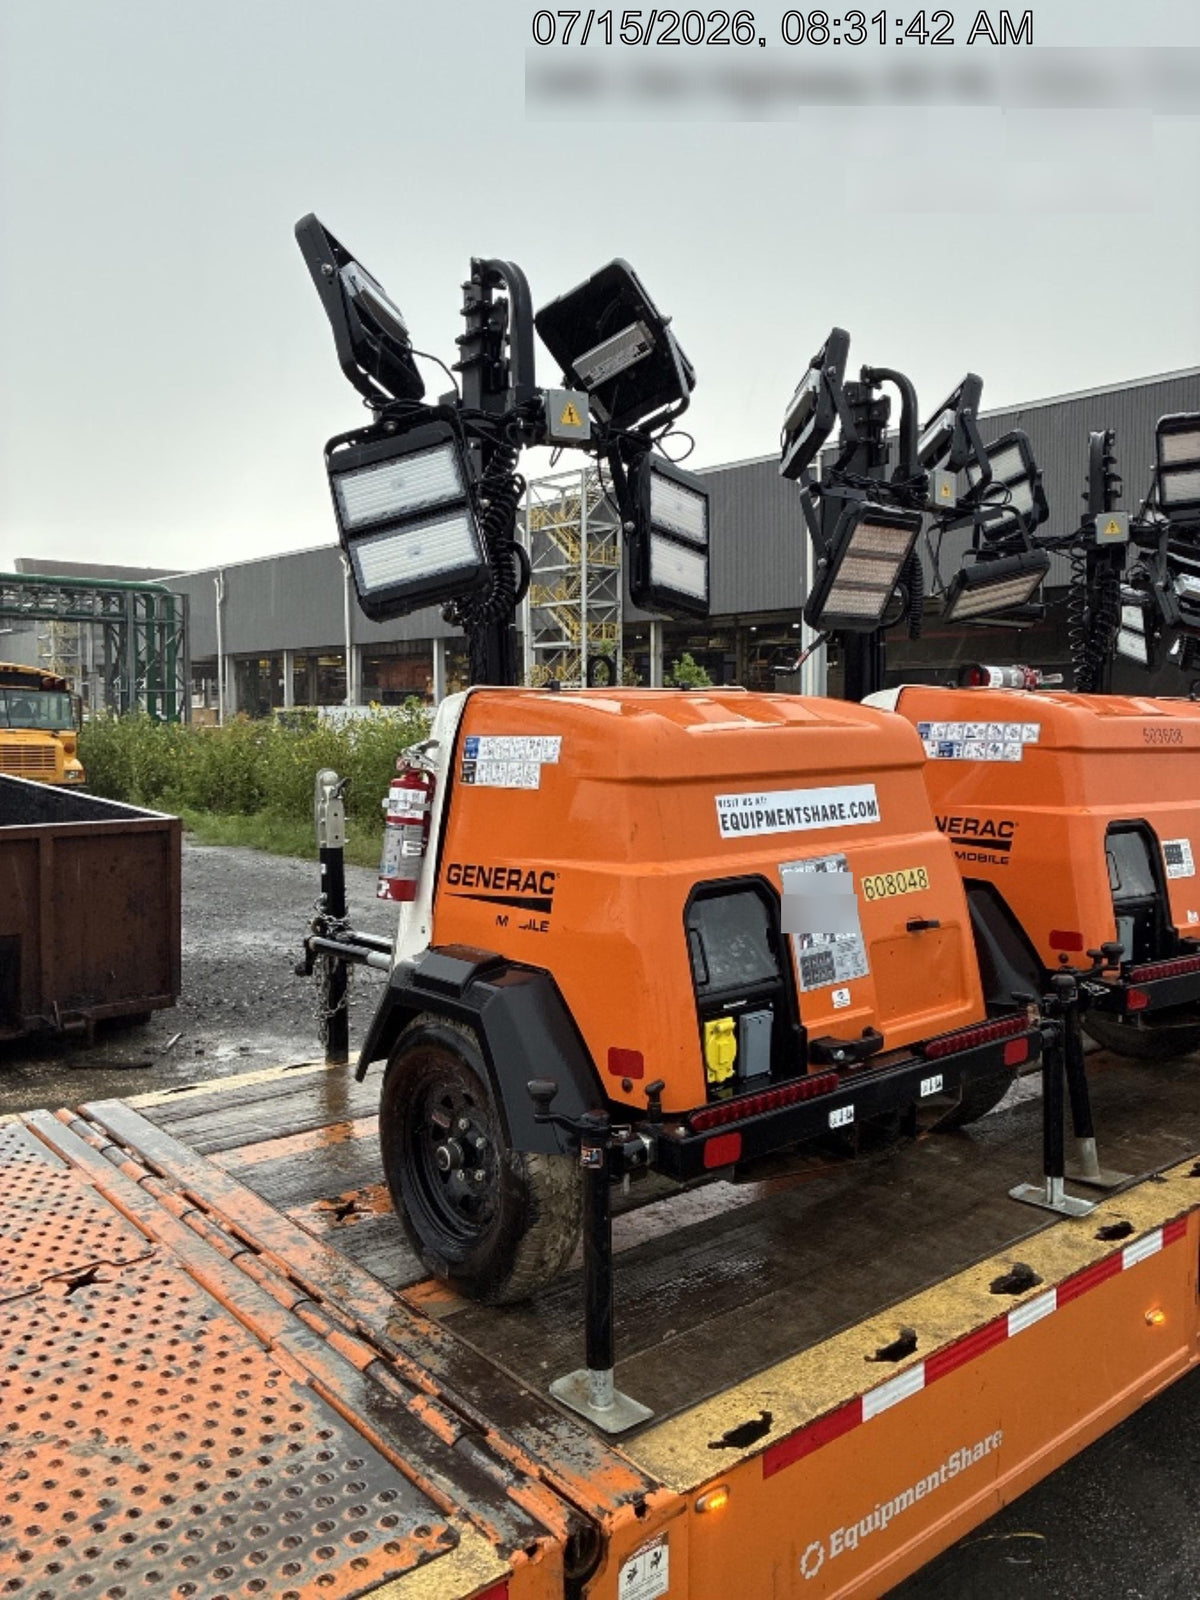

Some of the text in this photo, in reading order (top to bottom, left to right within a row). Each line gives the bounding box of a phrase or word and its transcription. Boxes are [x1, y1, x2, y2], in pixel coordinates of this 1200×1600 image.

[720, 799, 877, 831] EQUIPMENTSHARE.COM
[934, 815, 1014, 838] NERAC
[446, 863, 556, 895] GENERAC
[863, 868, 928, 900] 608048
[495, 915, 550, 932] MILE
[829, 1430, 1004, 1560] EquipmentShare
